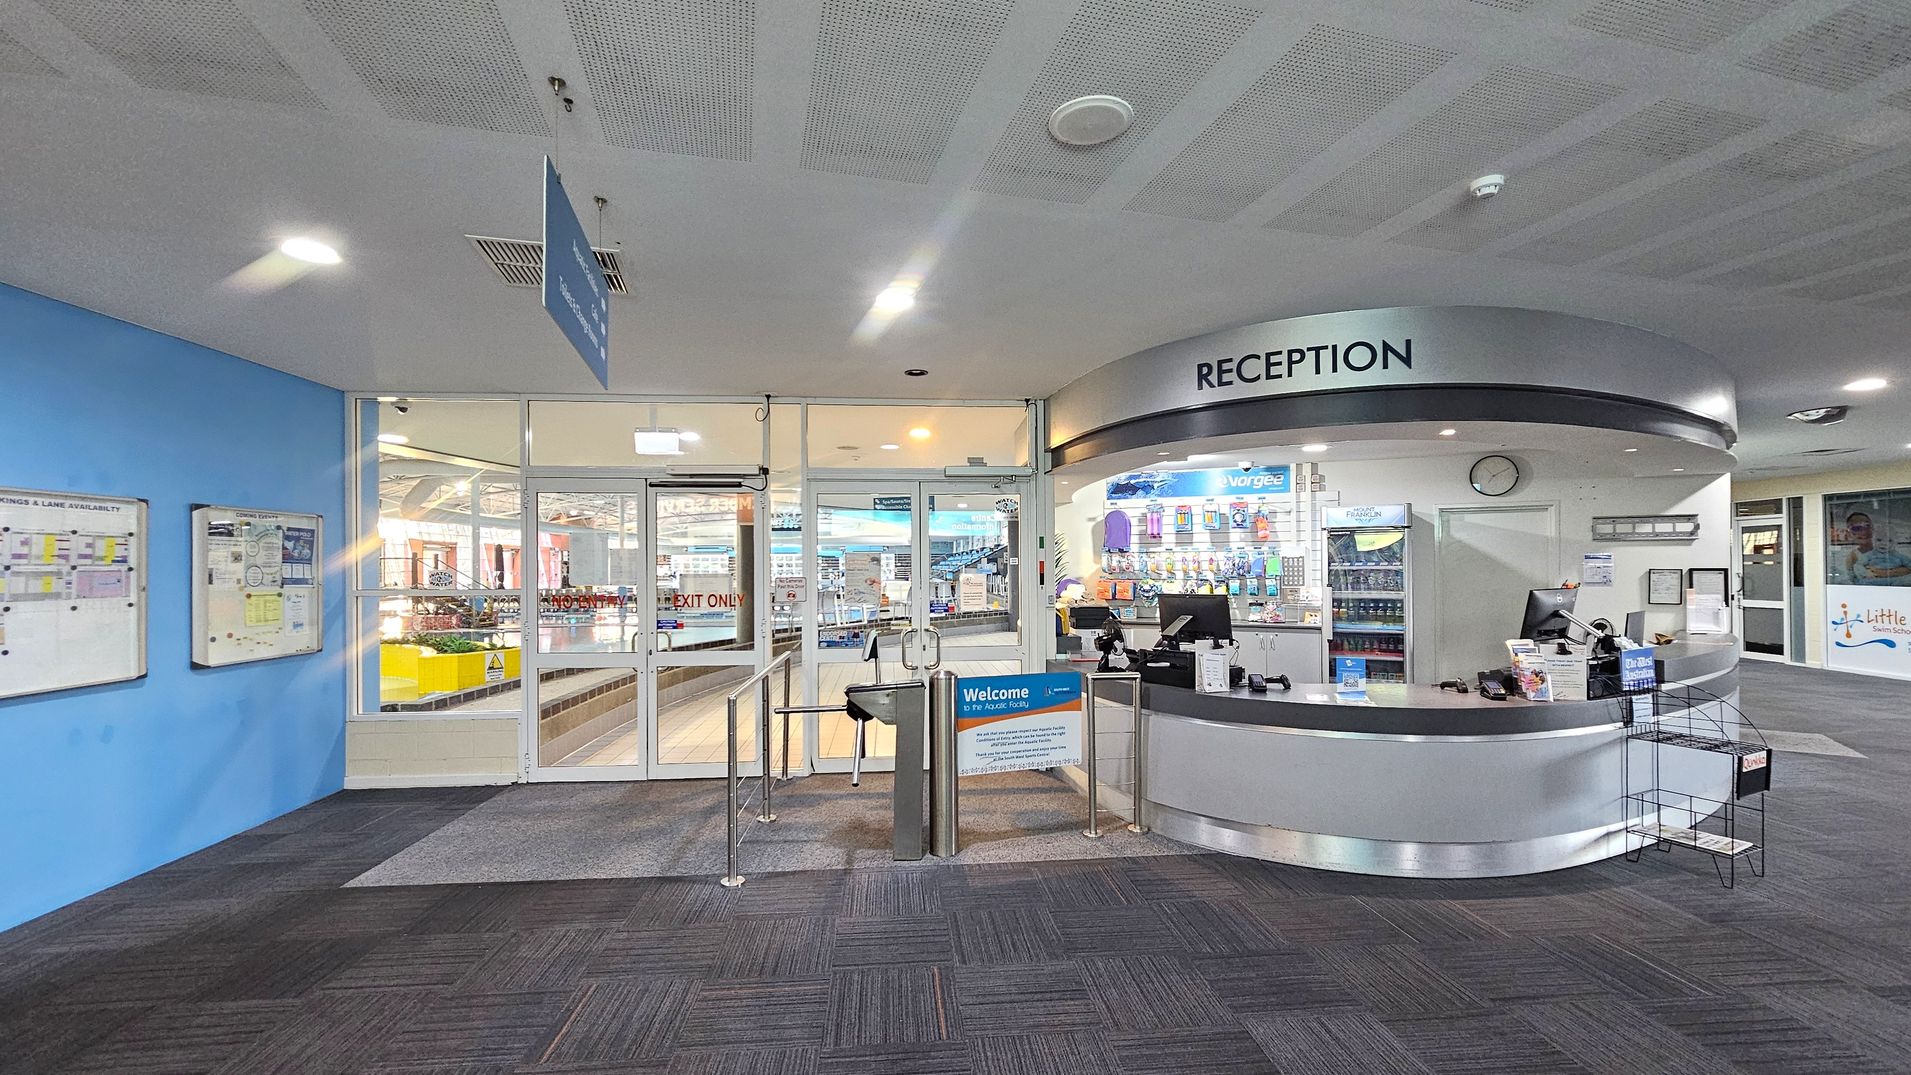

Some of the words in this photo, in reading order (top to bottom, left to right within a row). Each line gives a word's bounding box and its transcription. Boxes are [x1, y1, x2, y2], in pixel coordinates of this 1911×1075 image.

[1197, 339, 1412, 390] RECEPTION
[1227, 475, 1284, 488] vorgee
[551, 595, 573, 608] NO
[579, 594, 626, 608] ENTRY
[674, 594, 705, 608] EXIT
[707, 594, 745, 608] ONLY
[1867, 608, 1906, 626] Little
[1626, 658, 1636, 668] The
[1637, 656, 1653, 668] West
[1625, 669, 1655, 680] Australian
[963, 686, 1029, 701] Welcome
[985, 702, 1007, 710] Aquatic
